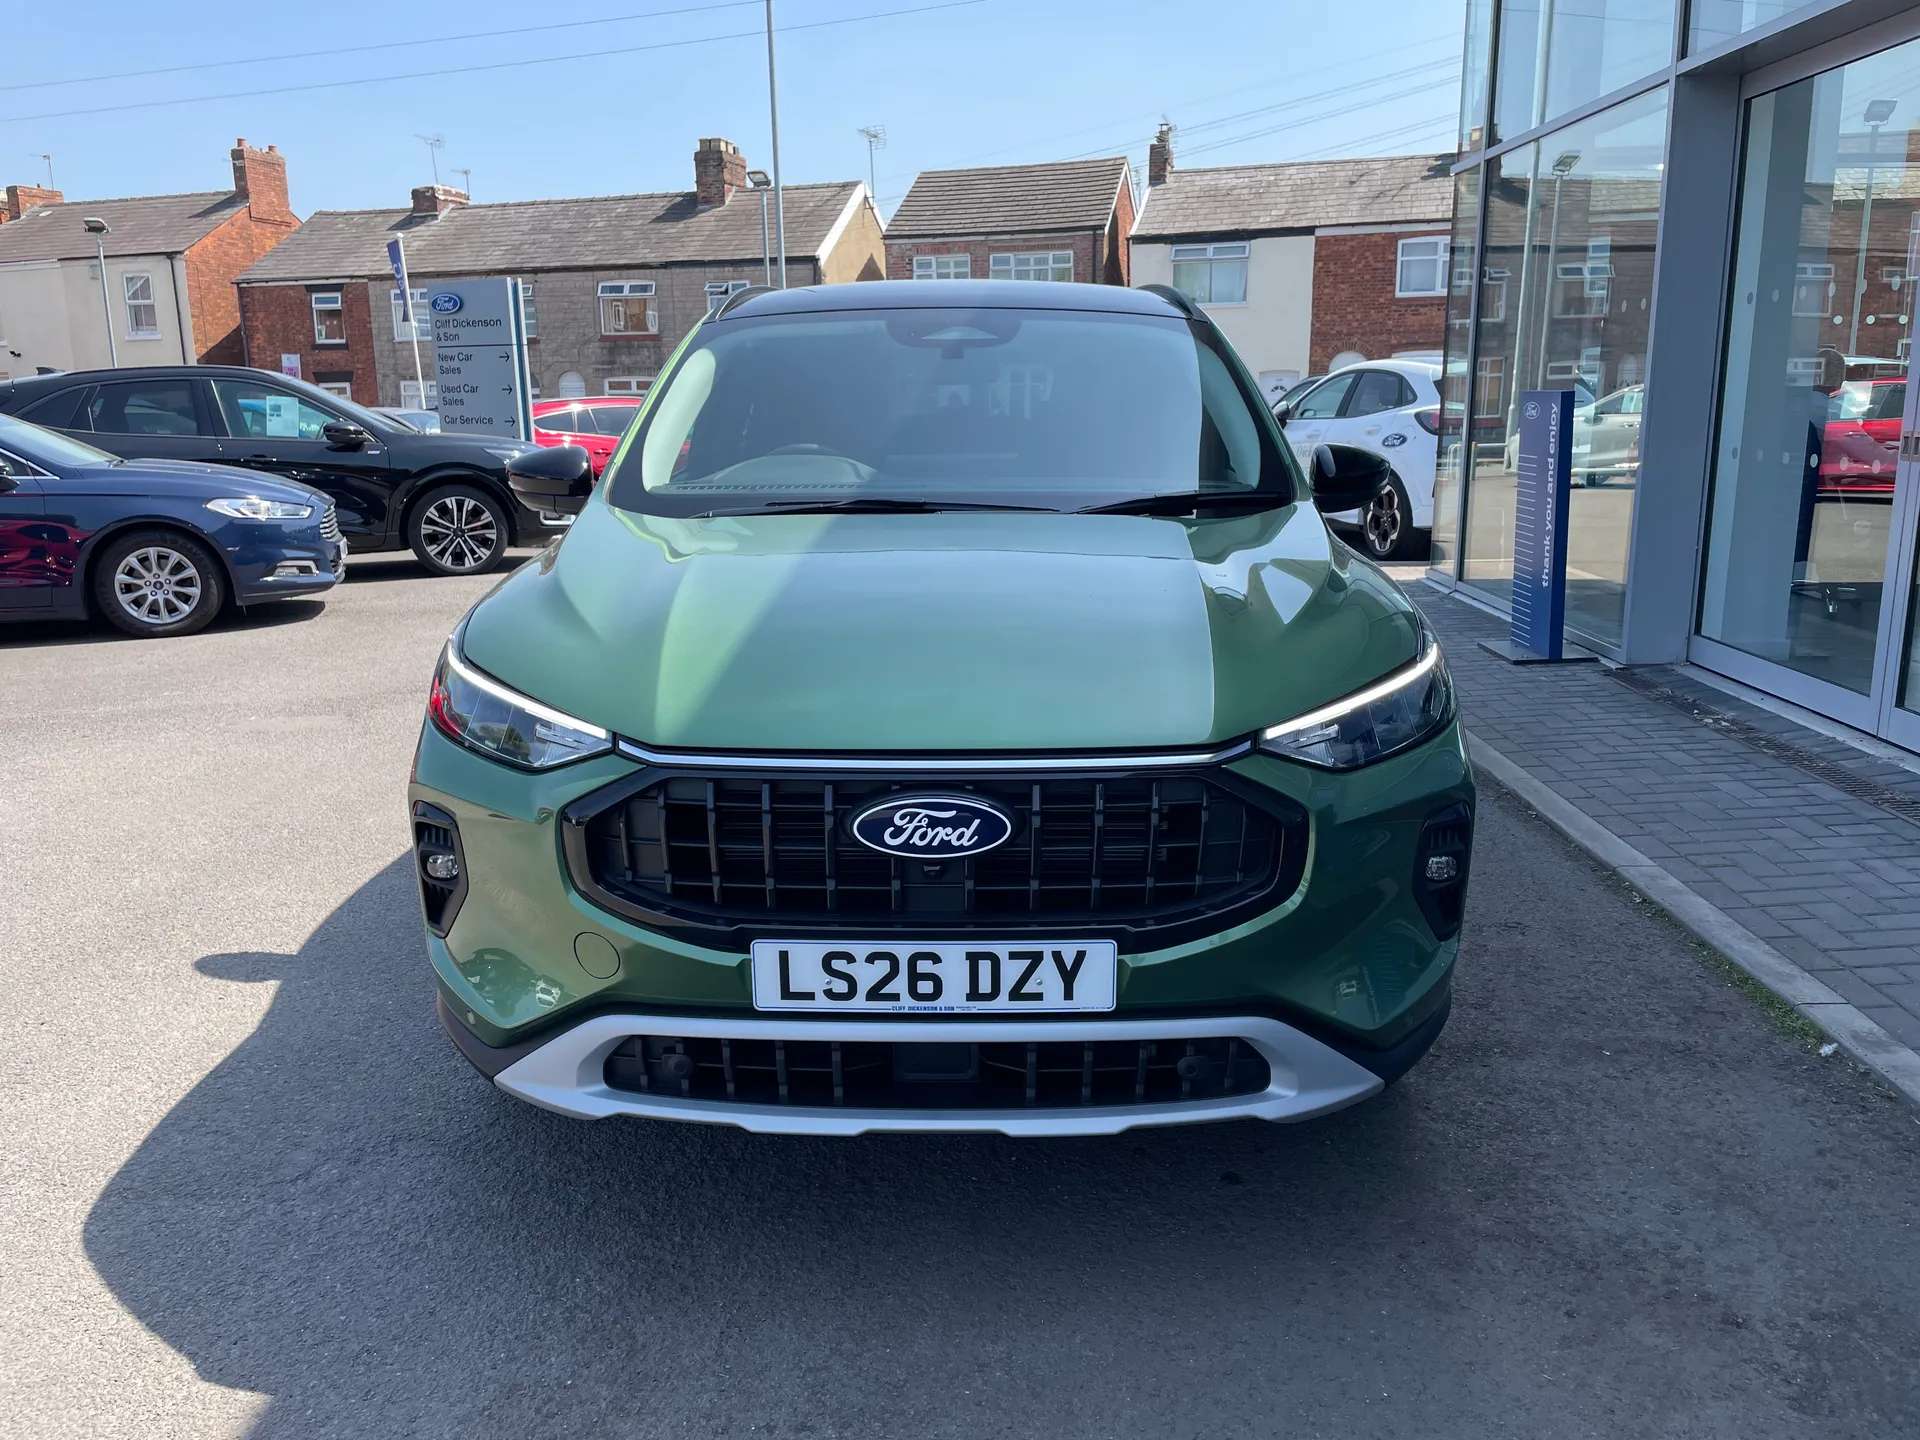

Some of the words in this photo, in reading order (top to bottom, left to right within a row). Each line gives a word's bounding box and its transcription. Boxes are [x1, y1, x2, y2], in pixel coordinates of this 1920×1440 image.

[435, 319, 451, 329] Cliff
[452, 318, 502, 328] Dickenson
[436, 333, 442, 342] &
[443, 332, 460, 341] Son
[438, 353, 456, 362] New
[457, 352, 473, 362] Car
[439, 366, 462, 375] Sales
[441, 385, 462, 394] Used
[463, 384, 479, 393] Car
[442, 397, 465, 406] Sales
[444, 415, 459, 425] Car
[460, 415, 494, 425] Service
[1548, 403, 1559, 454] enjoy
[1547, 457, 1555, 493] and
[1545, 499, 1553, 532] you
[1541, 538, 1551, 587] thank
[883, 808, 981, 847] Ford
[778, 950, 944, 1002] LS26
[965, 950, 1088, 1002] DZY
